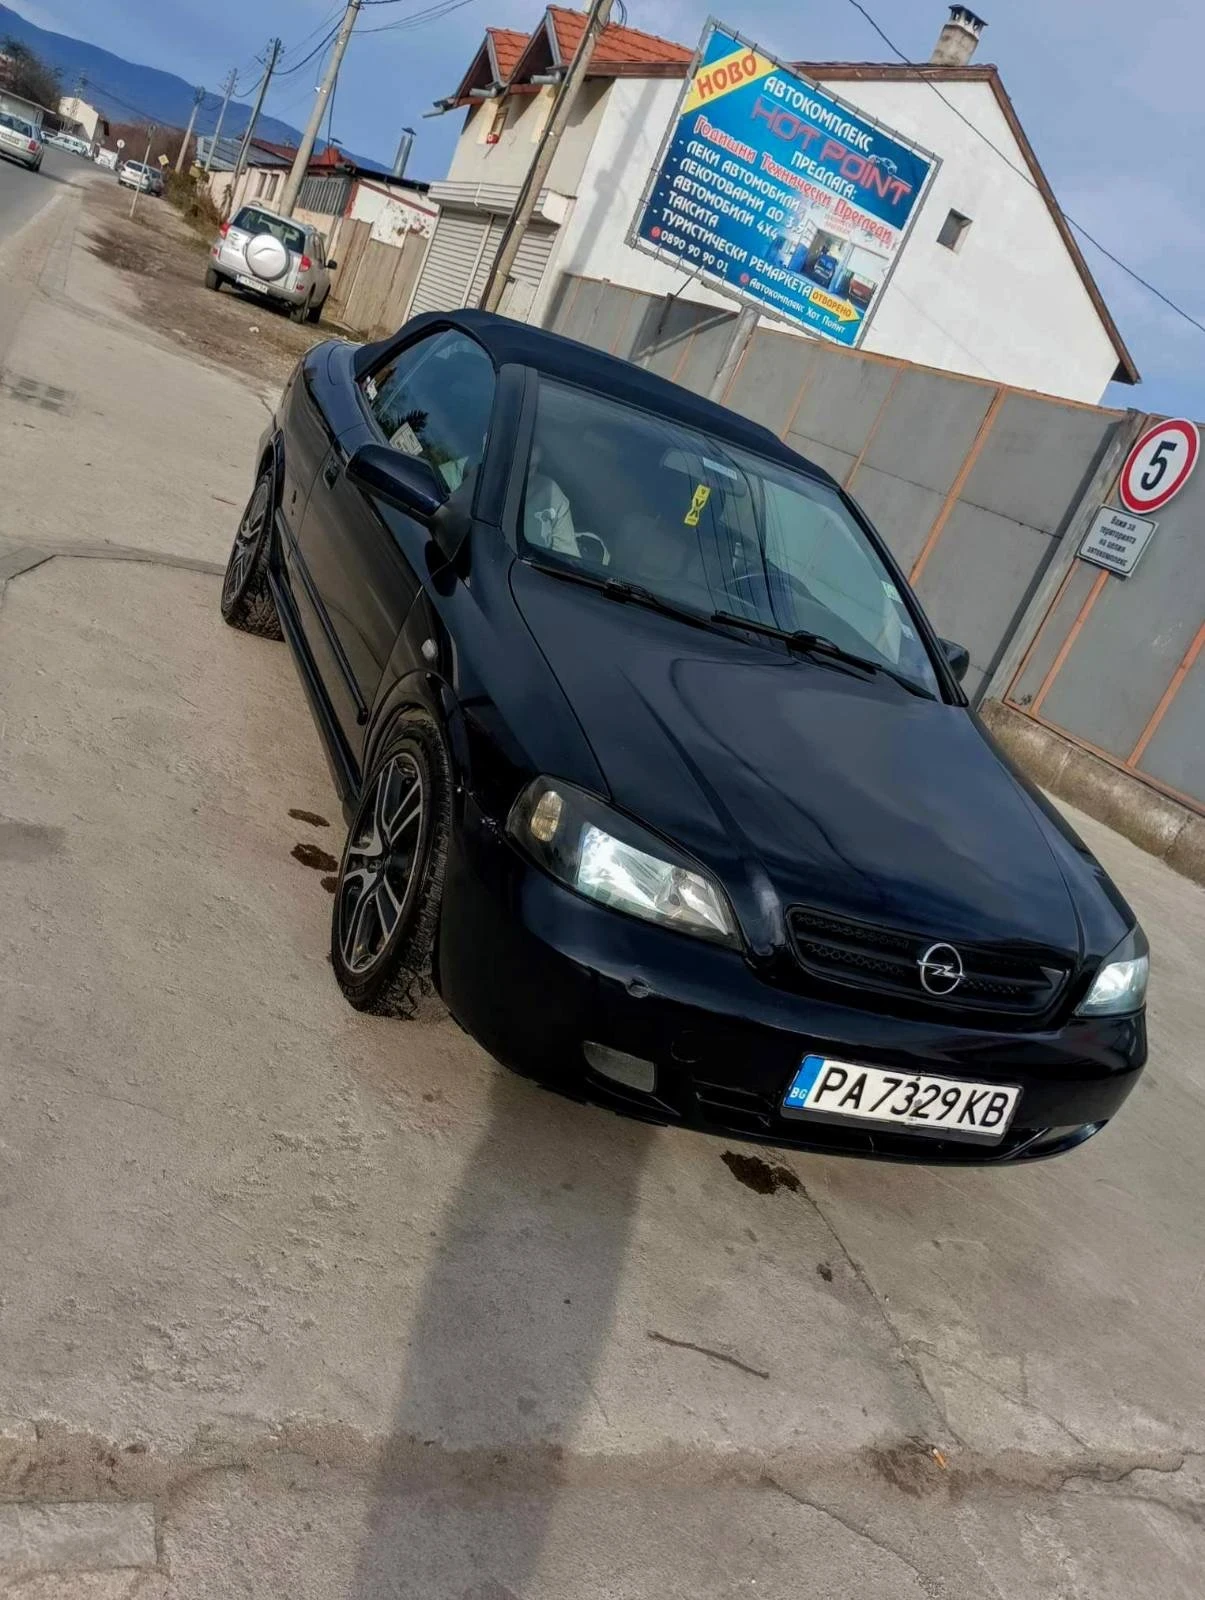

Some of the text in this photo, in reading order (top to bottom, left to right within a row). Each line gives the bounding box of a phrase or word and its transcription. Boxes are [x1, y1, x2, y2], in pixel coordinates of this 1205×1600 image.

[697, 54, 757, 99] НОВО
[763, 76, 873, 152] АВТОКОМПЛЕКС
[687, 141, 800, 210] ЛЕКИ АВТОМОБИЛИ
[693, 115, 758, 164] Годишни
[760, 152, 831, 207] Технически
[752, 97, 912, 205] HOT POINT
[791, 151, 857, 200] ПРЕДЛАГА:
[668, 191, 719, 228] ТАКСИТА
[673, 175, 755, 227] АВТОМОБИЛИ
[680, 158, 765, 212] ЛЕКОТОВАРНИ
[765, 206, 784, 223] ДО
[661, 230, 729, 273] 0890 90 90 01
[662, 208, 812, 297] ТУРИСТИЧЕСКИ РЕМАРКЕТА
[812, 291, 852, 317] ОТВОРЕНО
[1141, 440, 1178, 491] 5
[790, 1087, 806, 1099] BG
